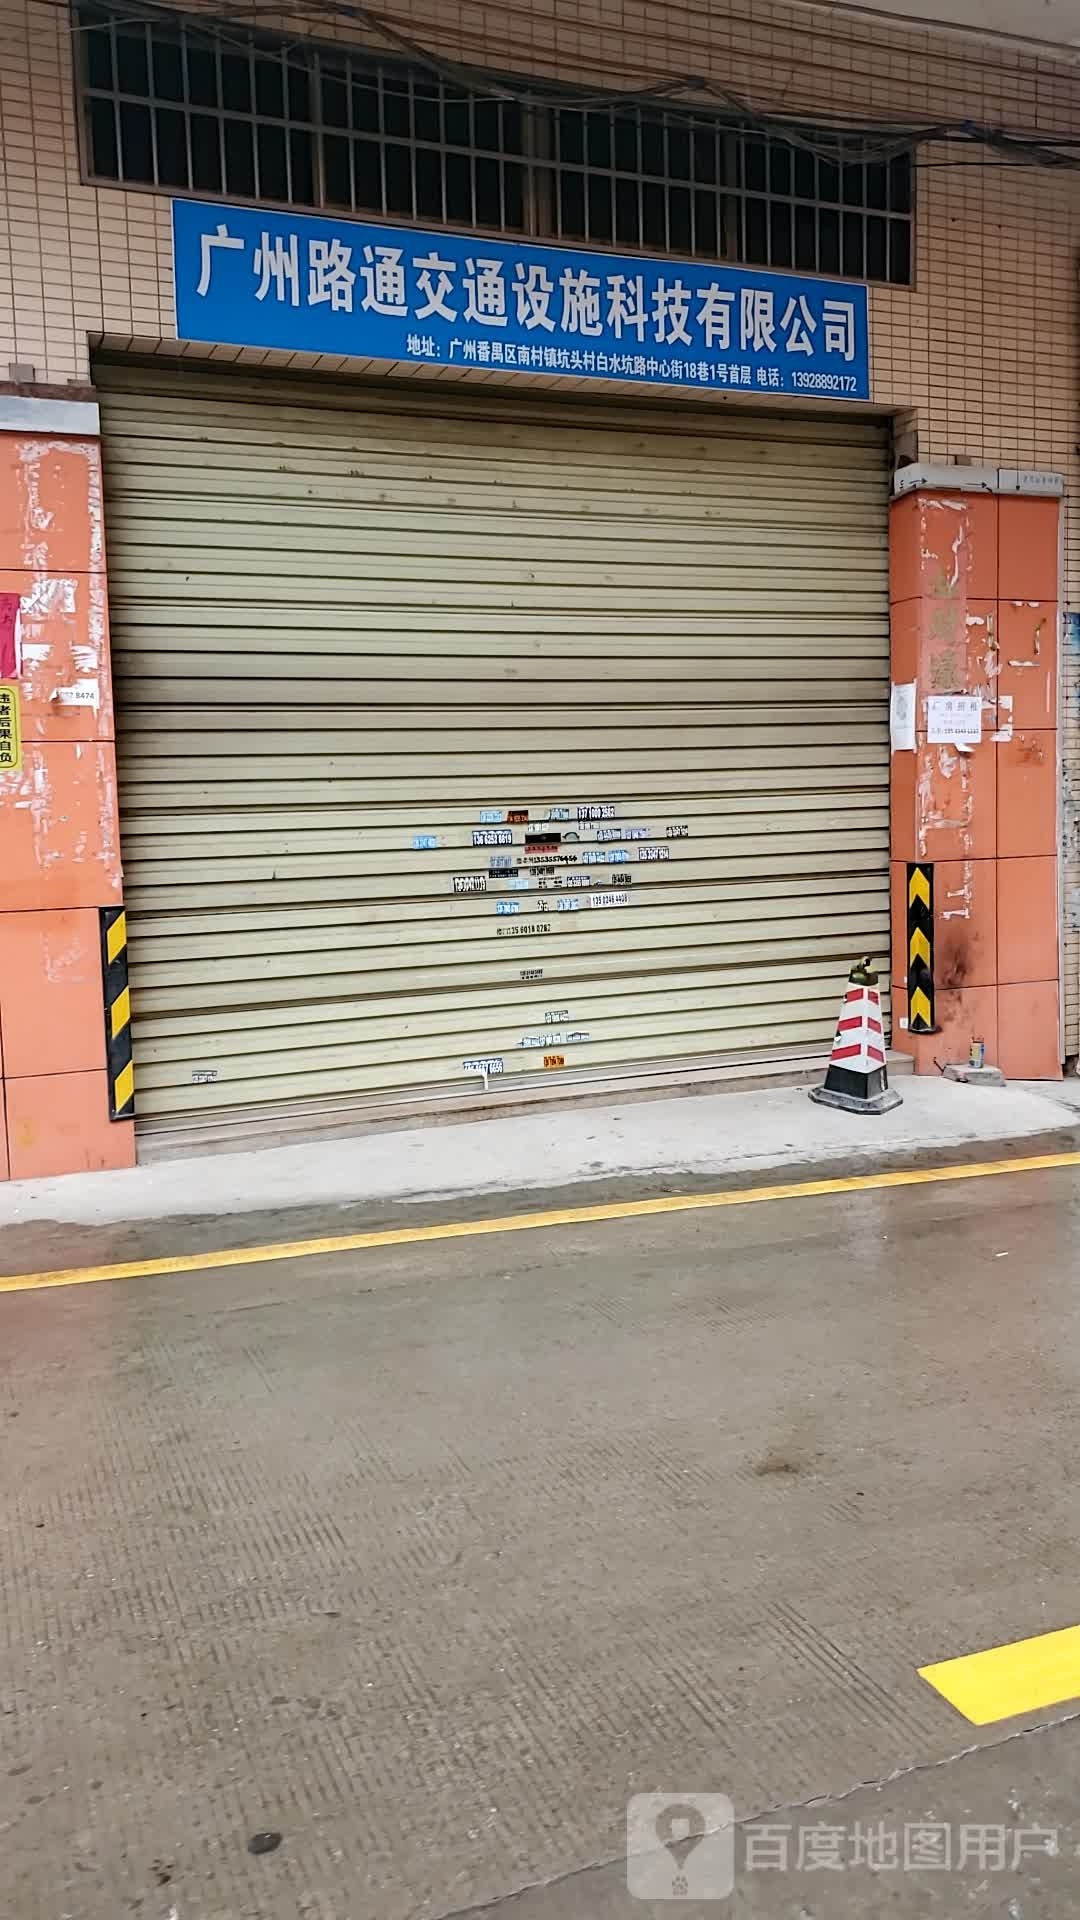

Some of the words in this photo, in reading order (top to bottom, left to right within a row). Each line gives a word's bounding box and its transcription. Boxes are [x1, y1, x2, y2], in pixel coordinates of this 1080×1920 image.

[196, 223, 856, 362] 广州路通交通设施科技有限公司
